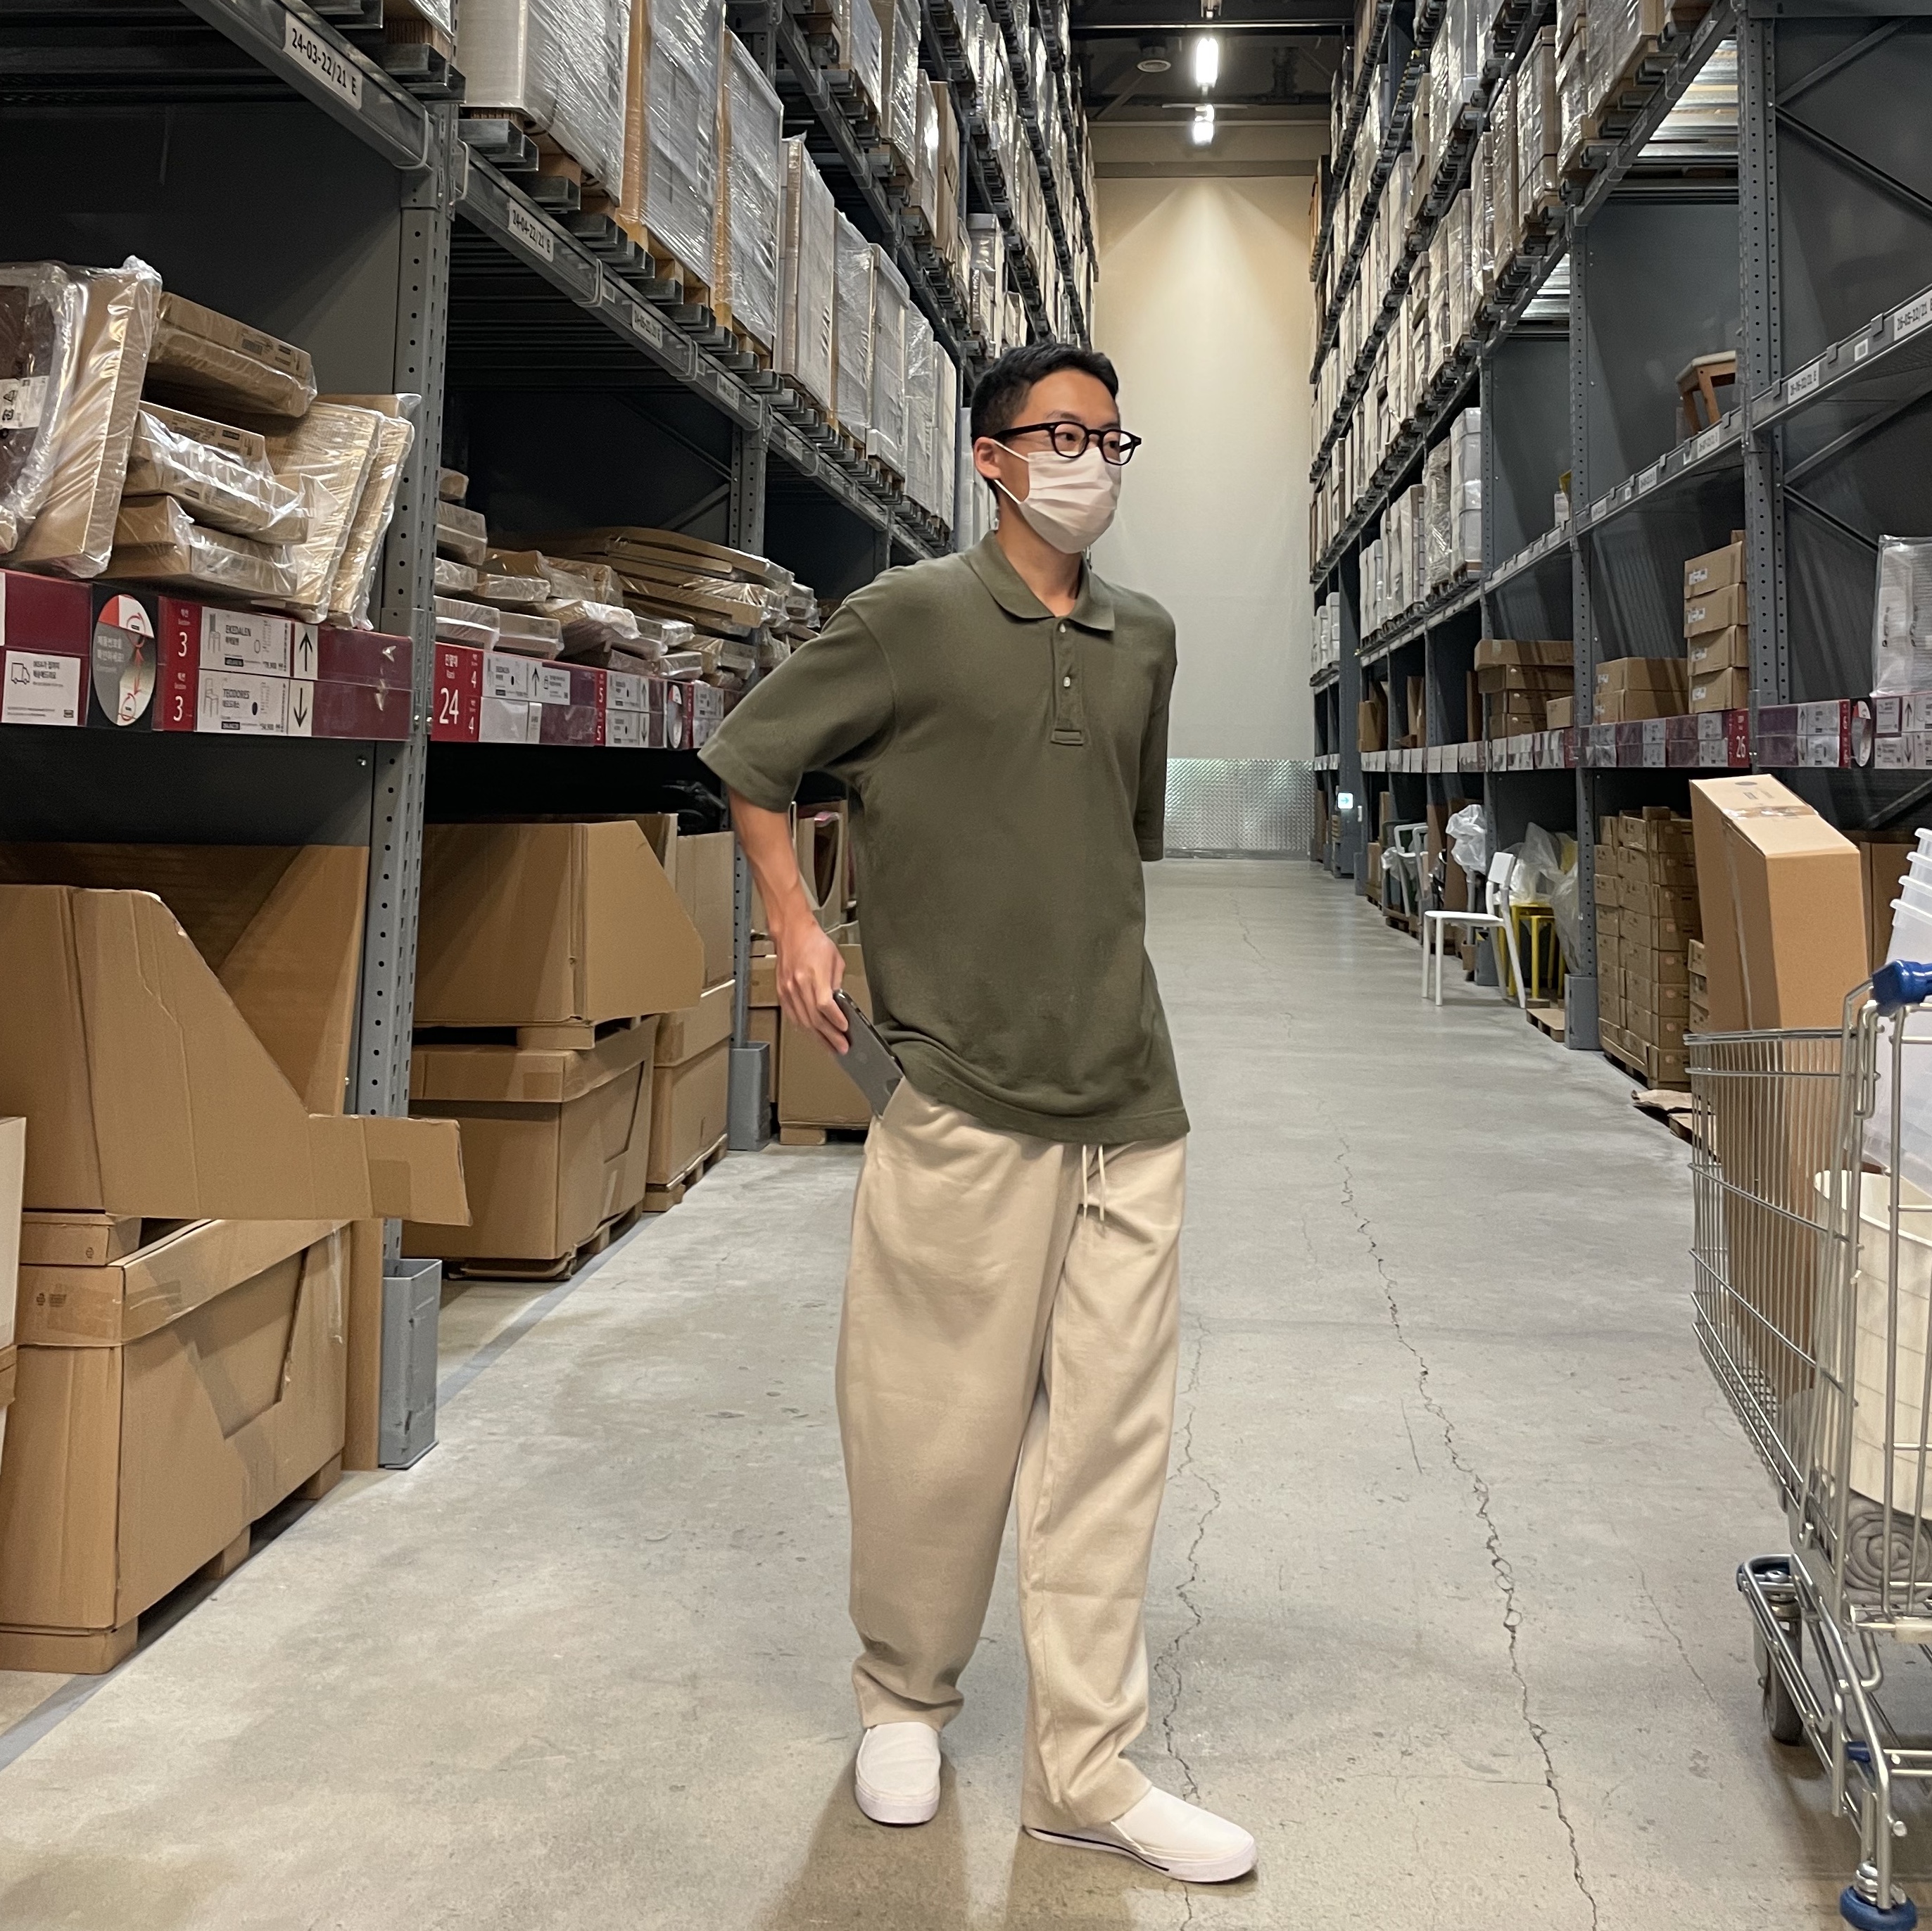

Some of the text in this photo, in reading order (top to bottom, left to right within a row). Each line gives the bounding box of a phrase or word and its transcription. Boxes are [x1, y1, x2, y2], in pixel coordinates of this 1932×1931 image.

[292, 28, 356, 96] 24-03-22/21 E
[178, 631, 187, 657] 3
[471, 671, 476, 688] 4
[173, 695, 183, 721] 3
[439, 687, 459, 724] 24
[468, 716, 474, 734] 4
[1736, 735, 1746, 758] 26
